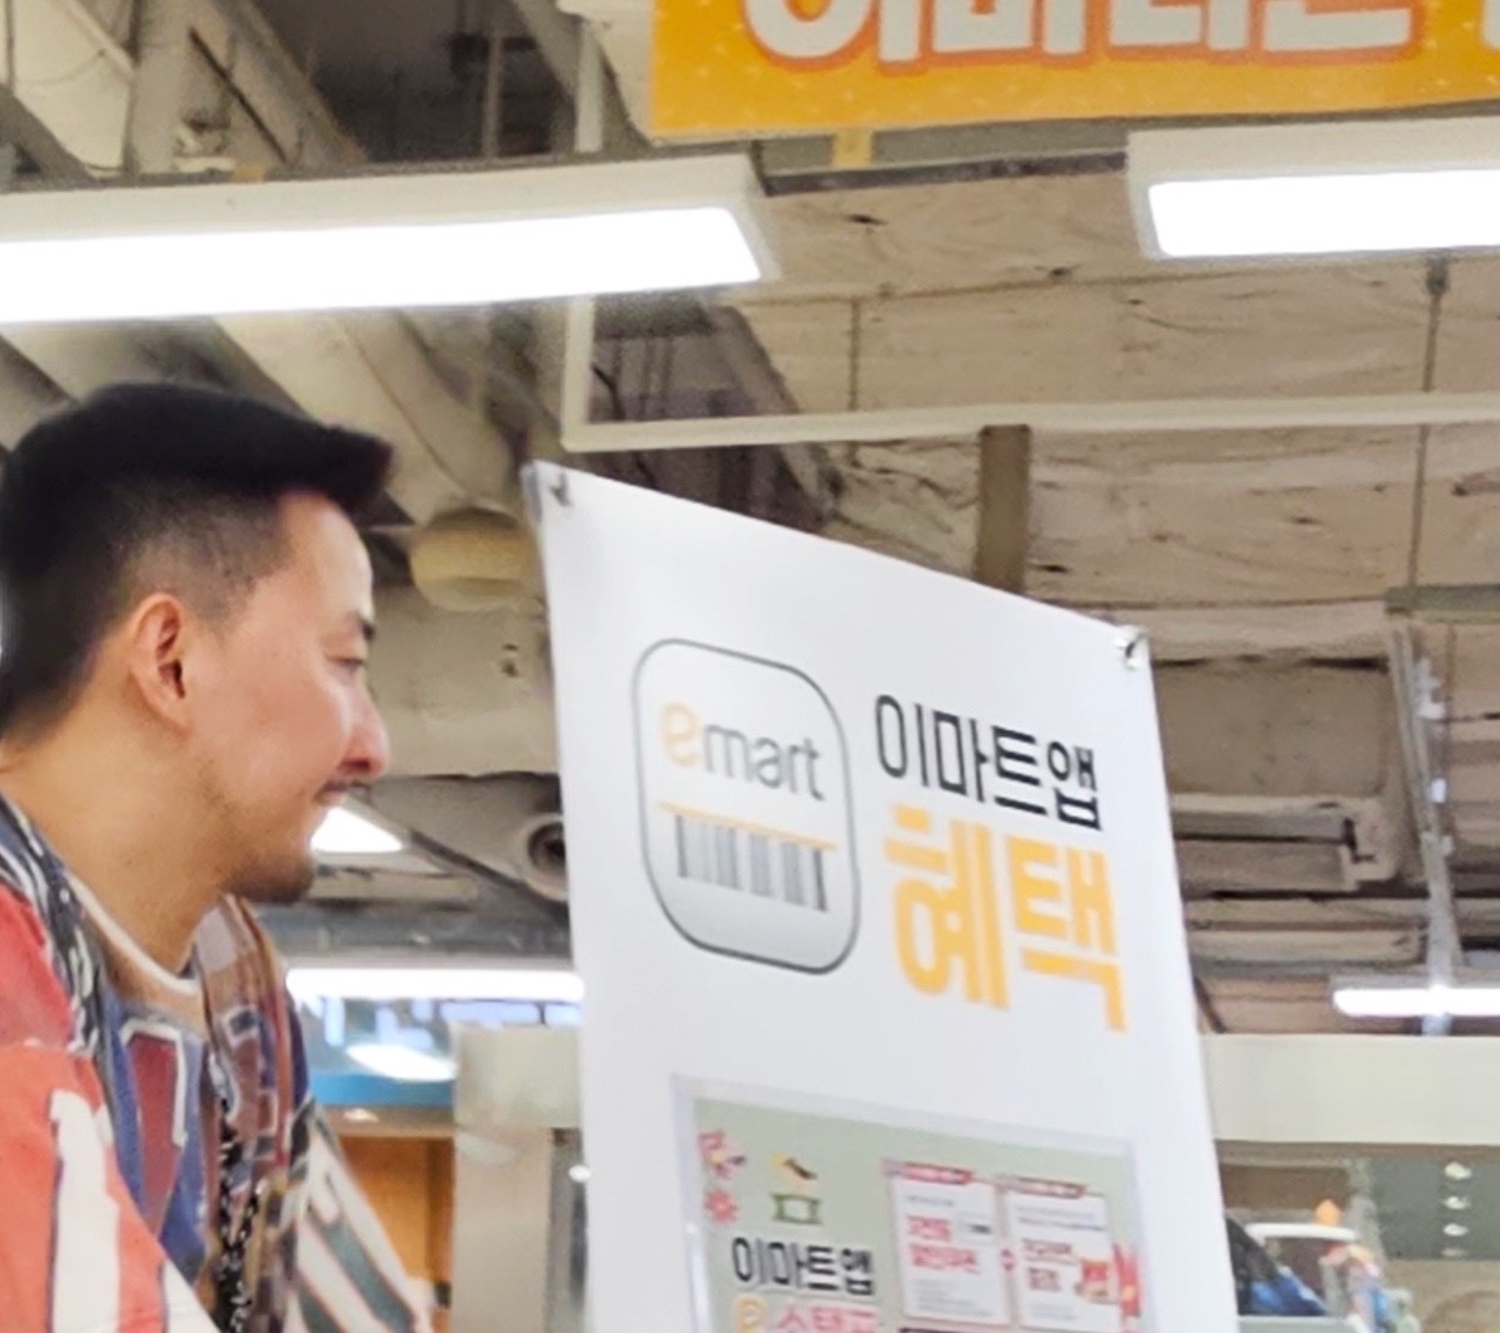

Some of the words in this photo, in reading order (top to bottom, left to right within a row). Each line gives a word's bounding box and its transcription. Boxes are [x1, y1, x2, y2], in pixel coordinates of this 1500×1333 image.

[660, 701, 825, 801] emart
[874, 694, 1104, 832] 이마트앱
[884, 802, 1127, 1033] 혜택
[732, 1236, 874, 1296] 이마트앱
